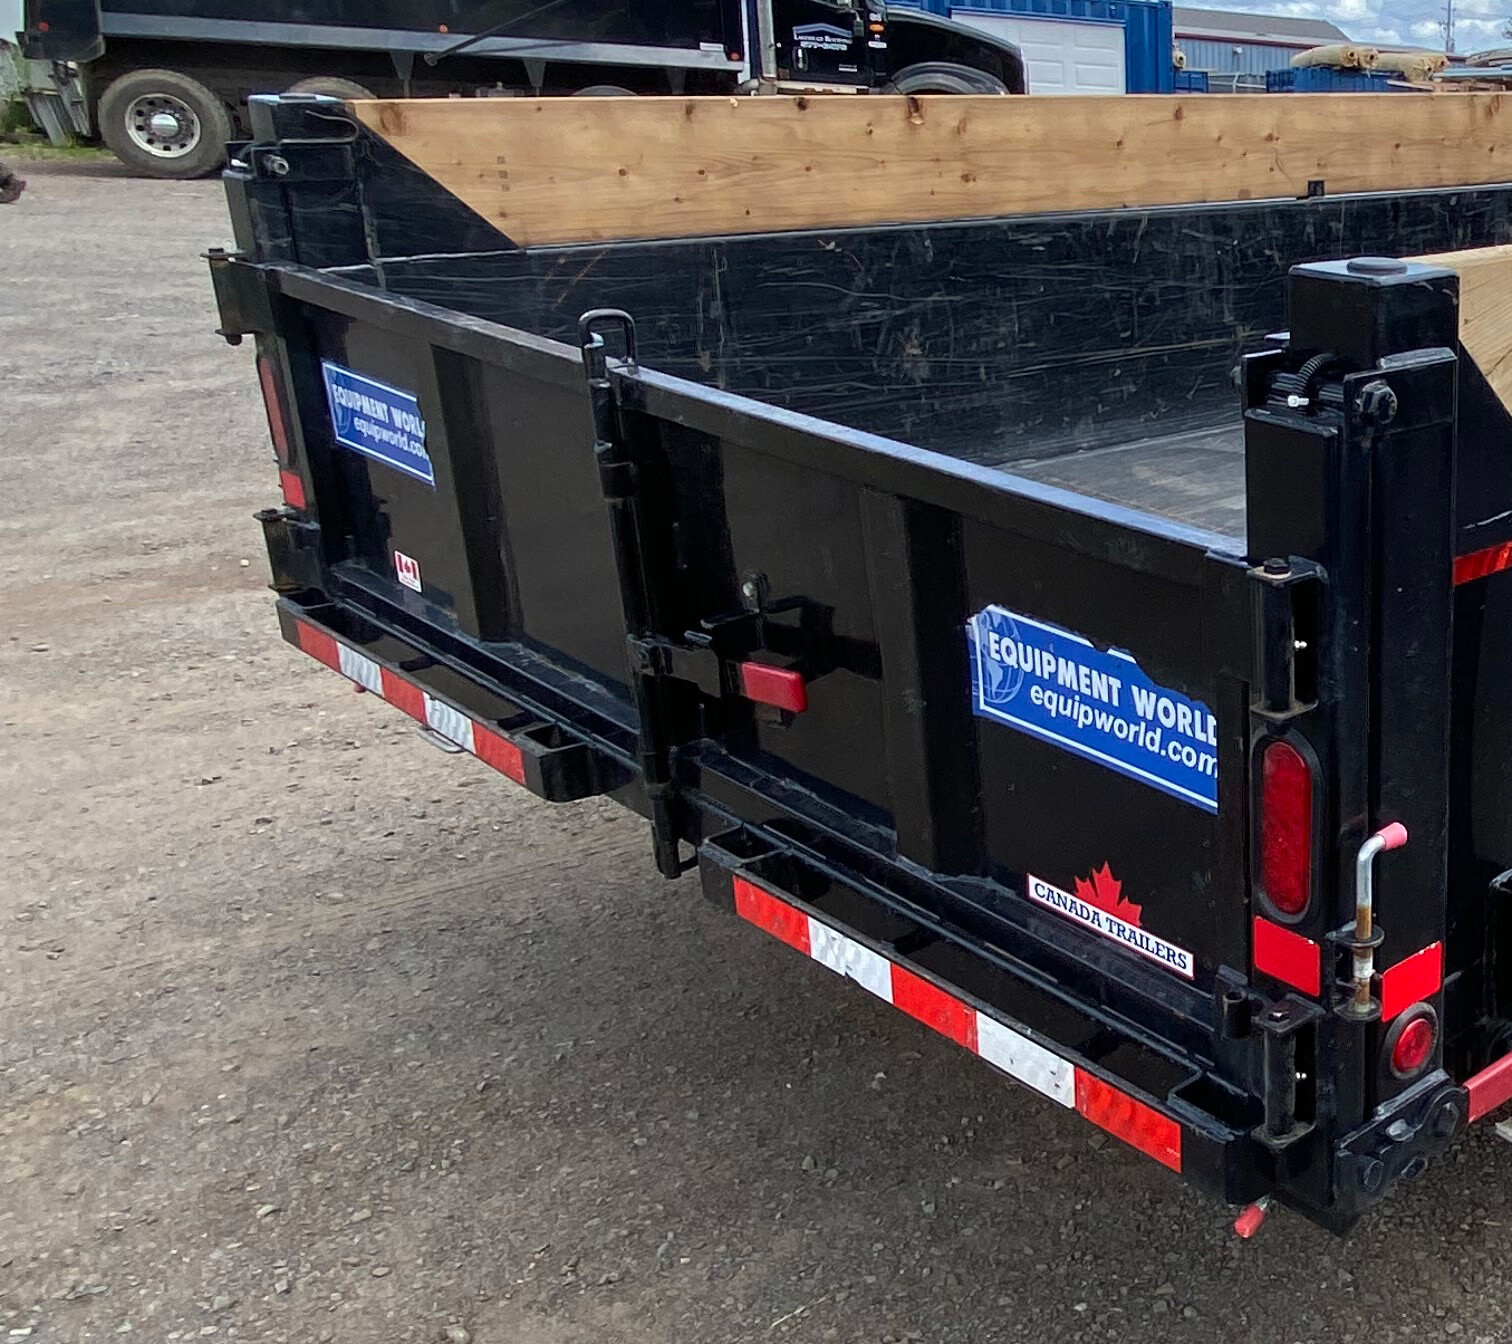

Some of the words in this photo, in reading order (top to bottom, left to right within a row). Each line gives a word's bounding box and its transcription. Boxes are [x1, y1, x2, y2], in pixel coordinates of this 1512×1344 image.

[332, 383, 389, 424] EQUIPMENT
[988, 631, 1122, 707] EQUIPMENT
[1034, 882, 1102, 928] CANADA
[1105, 916, 1187, 970] TRAILERS
